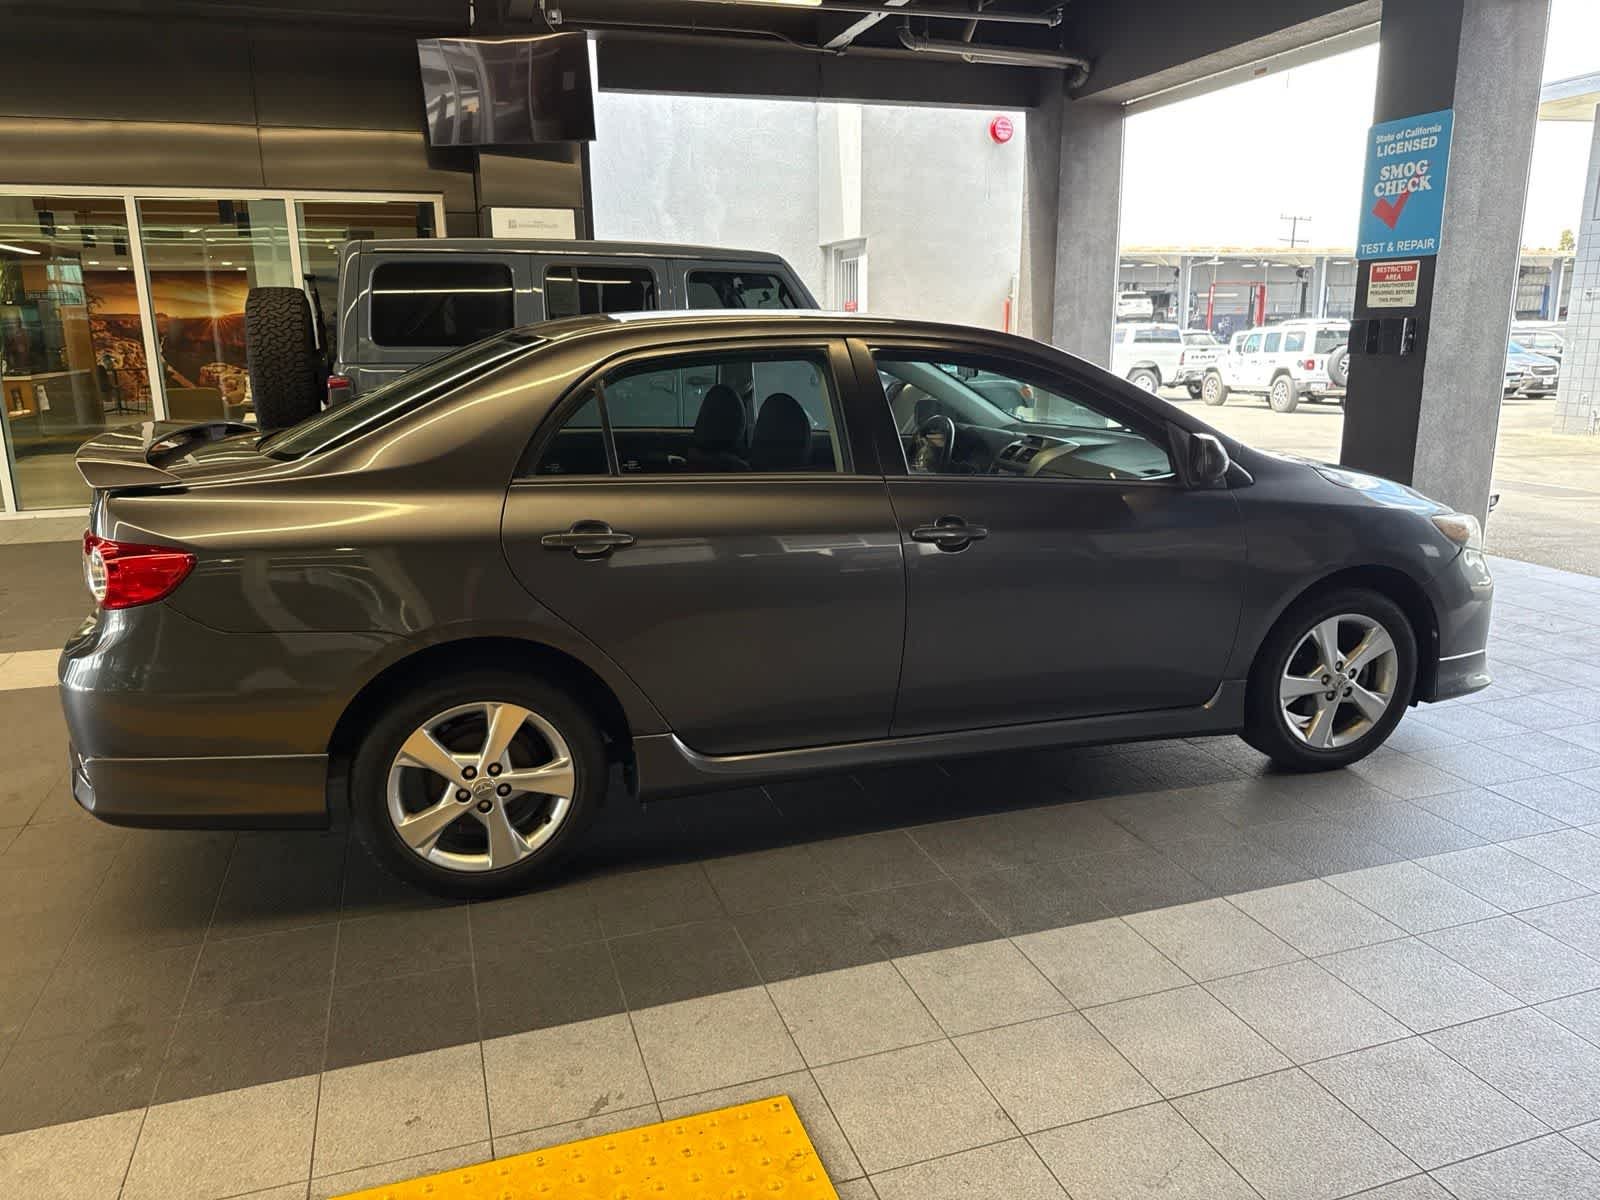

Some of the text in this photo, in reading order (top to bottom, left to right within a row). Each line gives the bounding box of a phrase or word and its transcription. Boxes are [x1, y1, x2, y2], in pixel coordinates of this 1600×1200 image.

[1376, 124, 1442, 143] State of California
[1376, 136, 1438, 157] LICENSED
[1380, 160, 1429, 181] SMOG
[1374, 175, 1432, 197] CHECK
[1361, 238, 1435, 254] TEST & REPAIR
[1376, 265, 1413, 273] RESTRICTED
